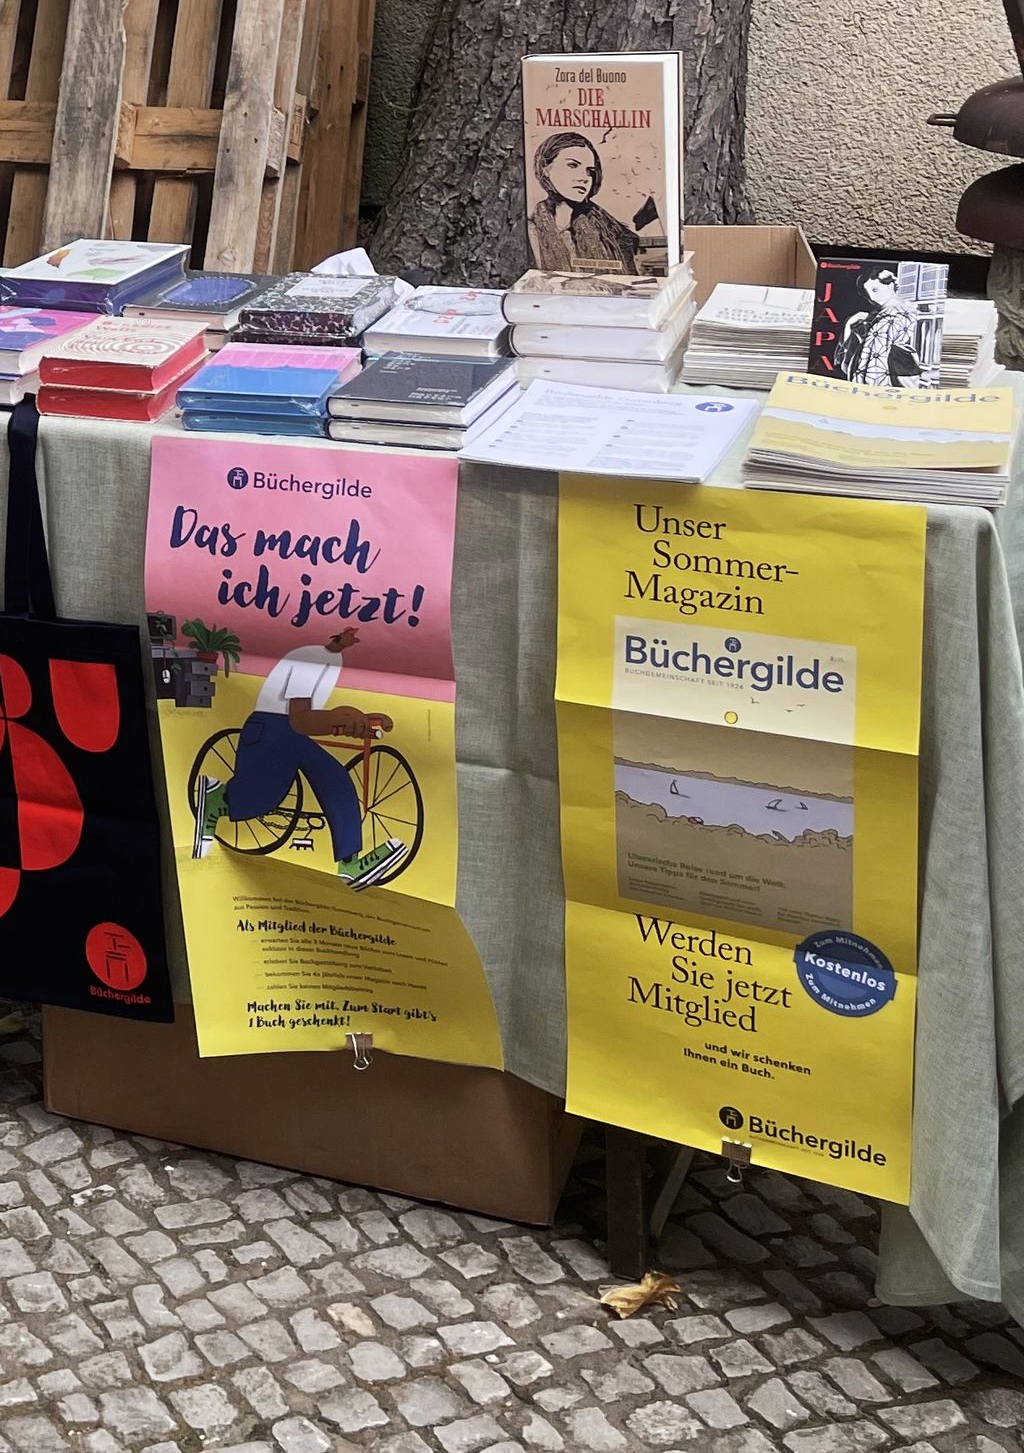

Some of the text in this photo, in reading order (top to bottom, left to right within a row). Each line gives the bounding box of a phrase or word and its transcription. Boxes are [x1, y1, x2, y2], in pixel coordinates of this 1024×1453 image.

[555, 68, 627, 83] Zora del Buono
[577, 88, 605, 107] DIE
[536, 108, 651, 128] MARSCHALLIN
[786, 375, 1001, 405] Büchergilde
[253, 471, 373, 499] Büchergilde
[634, 503, 727, 540] Unser
[170, 505, 381, 573] Das mach
[653, 539, 799, 583] Sommer-
[218, 564, 425, 627] ich jetzt!
[624, 570, 765, 616] Magazin
[625, 634, 845, 693] Büchergilde
[707, 678, 724, 687] SEIT
[237, 919, 397, 946] Als Mitglied der Büchergilde
[634, 913, 753, 966] Werden
[813, 938, 833, 948] Zum
[671, 955, 792, 1009] Sie jetzt
[804, 951, 886, 991] Kostenlos
[89, 985, 152, 1005] Büchergilde
[247, 1000, 291, 1013] Machen
[294, 999, 312, 1011] Sie
[314, 1001, 340, 1012] mit.
[342, 1000, 369, 1013] Zum
[371, 1002, 401, 1016] Start
[627, 976, 758, 1033] Mitglied
[805, 973, 877, 1011] Zum Mitnehmen
[249, 1013, 351, 1029] 1 Buch geschenkt!
[683, 1048, 776, 1080] Ihnen ein Buch.
[704, 1042, 812, 1076] und wir schenken
[749, 1115, 887, 1166] Büchergilde
